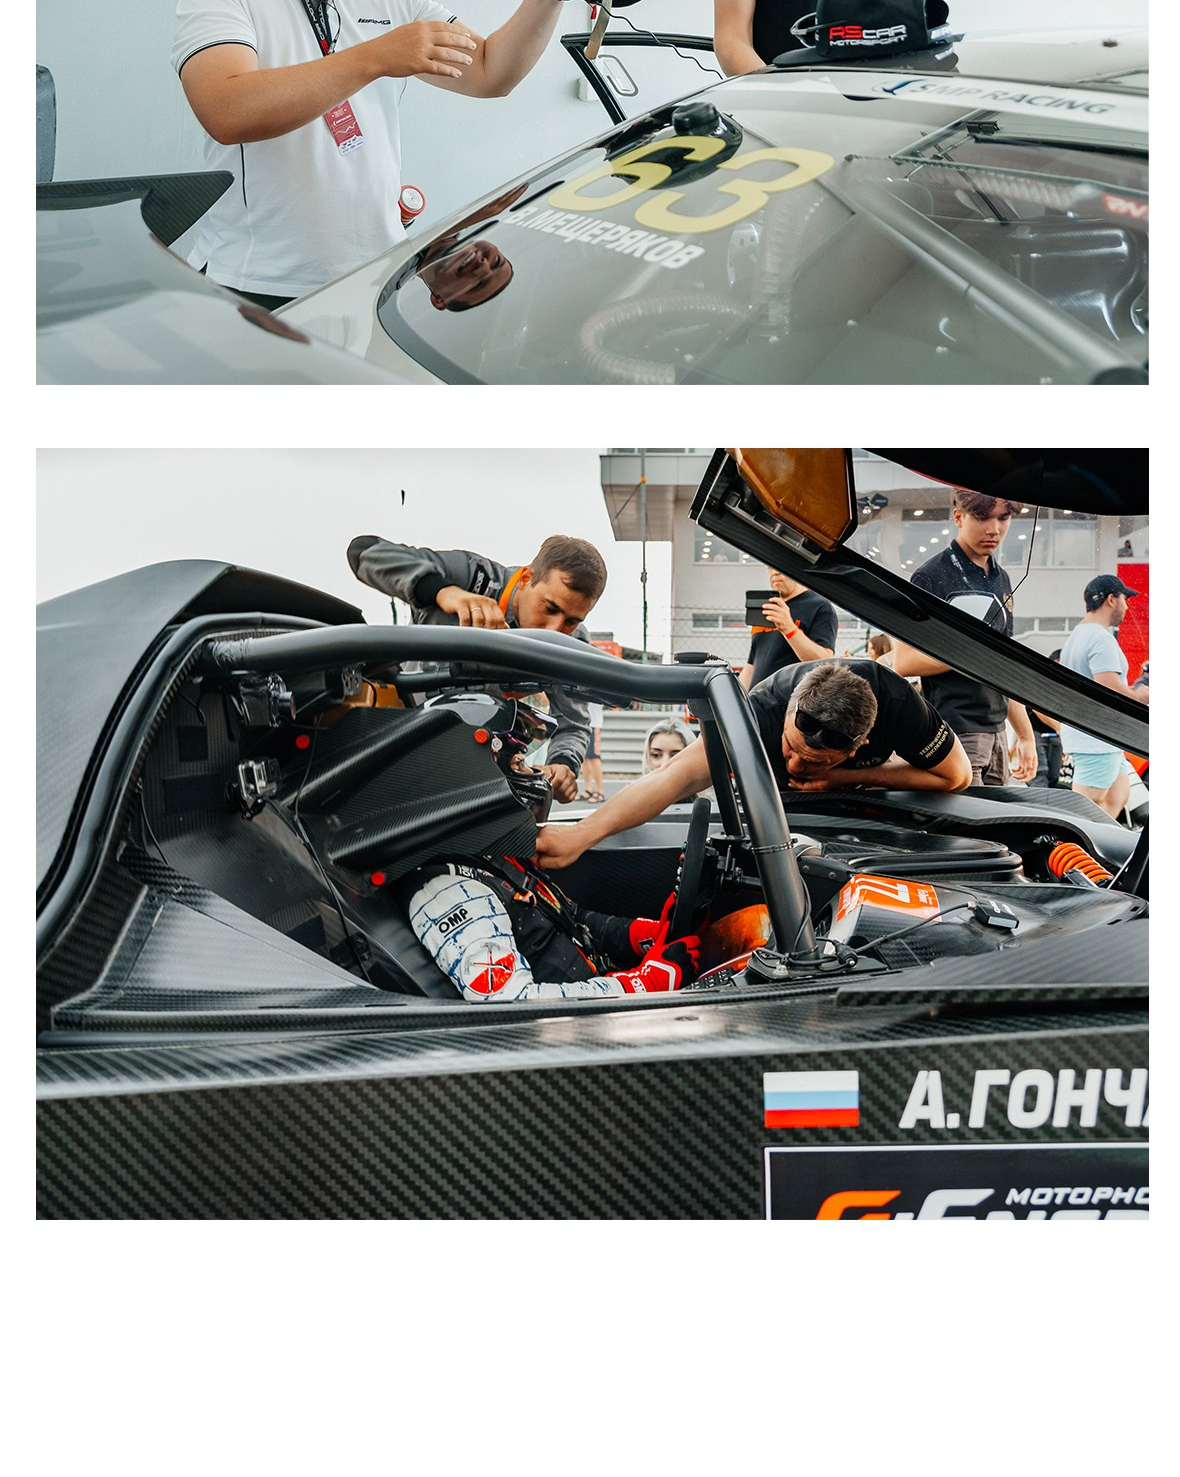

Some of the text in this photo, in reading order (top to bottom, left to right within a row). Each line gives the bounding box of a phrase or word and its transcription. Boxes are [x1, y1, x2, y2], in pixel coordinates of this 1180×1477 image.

[829, 25, 908, 40] RSCAR
[984, 91, 1117, 114] RACING
[547, 135, 835, 234] 63
[438, 908, 470, 935] OMP
[899, 1068, 1149, 1129] А.ГОНЧ
